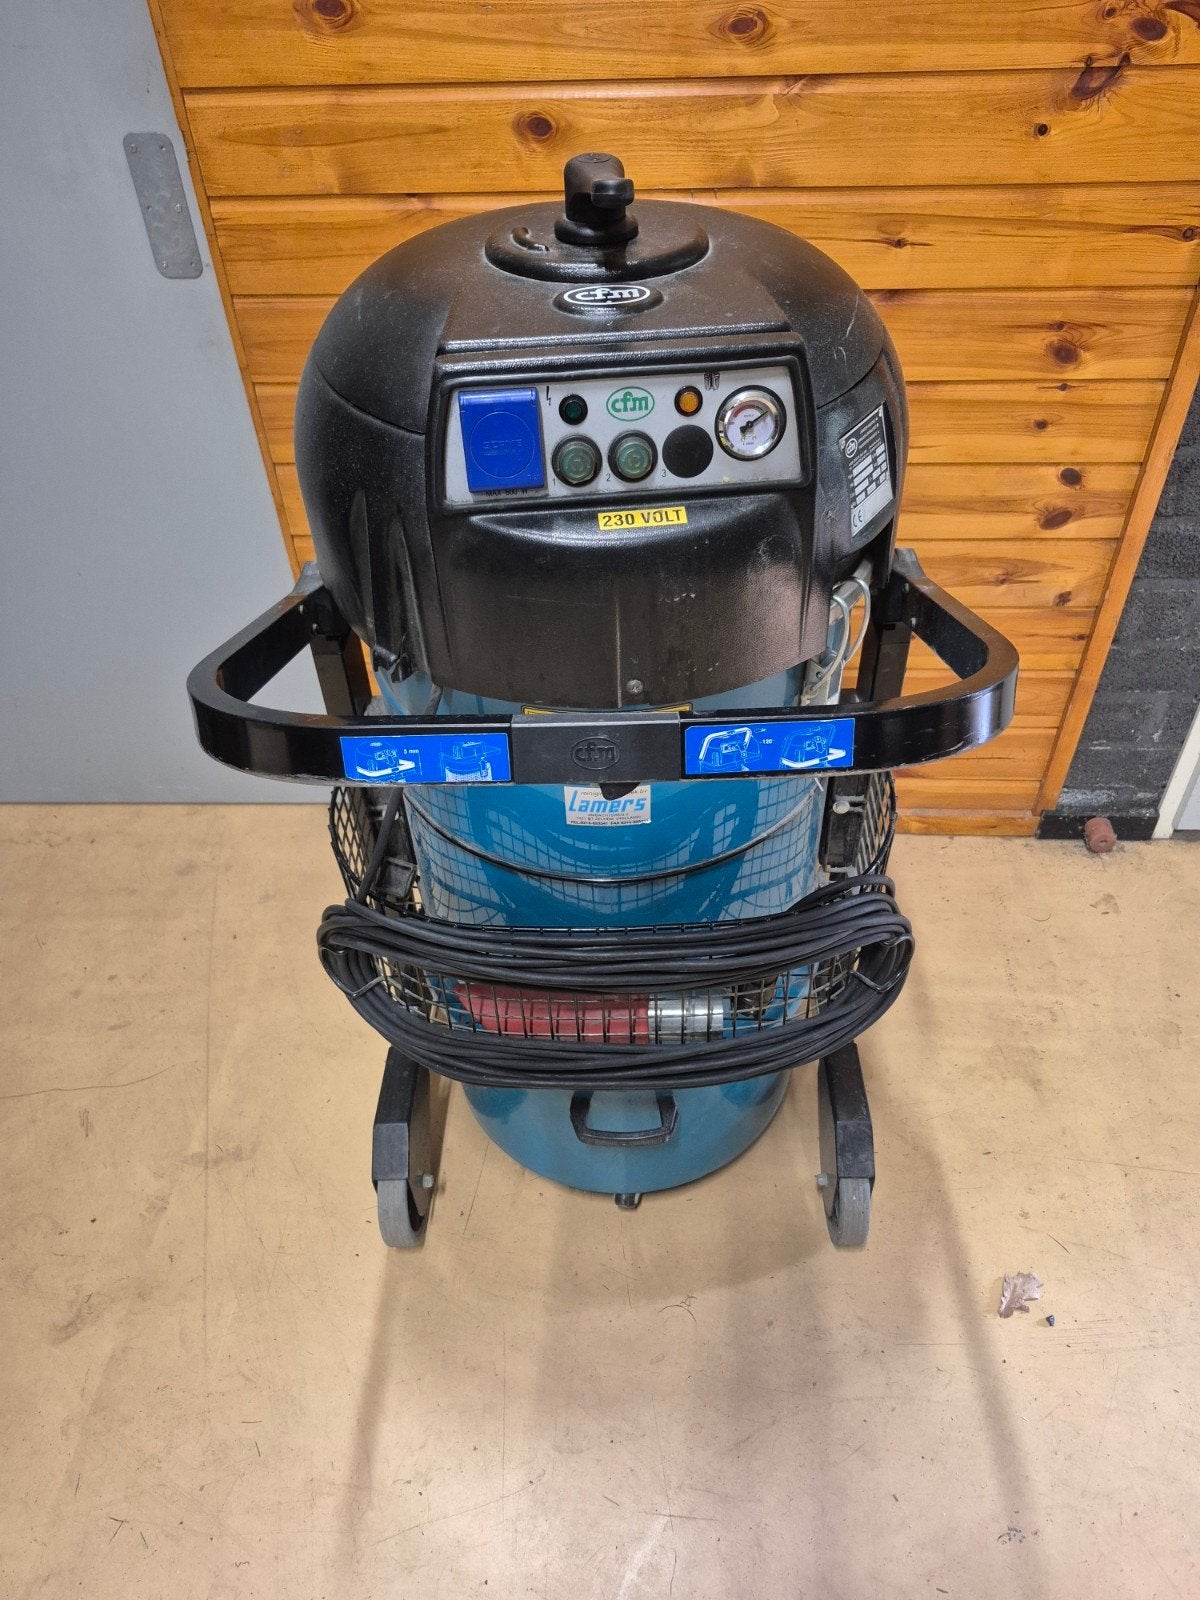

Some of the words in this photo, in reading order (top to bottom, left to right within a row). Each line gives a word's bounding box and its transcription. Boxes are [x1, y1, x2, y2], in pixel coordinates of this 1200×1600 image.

[575, 288, 640, 301] cfm
[610, 391, 649, 413] cfm
[605, 473, 611, 482] 2
[661, 469, 667, 478] 3
[603, 513, 635, 527] 230
[641, 509, 682, 524] VOLT
[573, 742, 616, 763] cfm
[568, 790, 647, 813] Lamers
